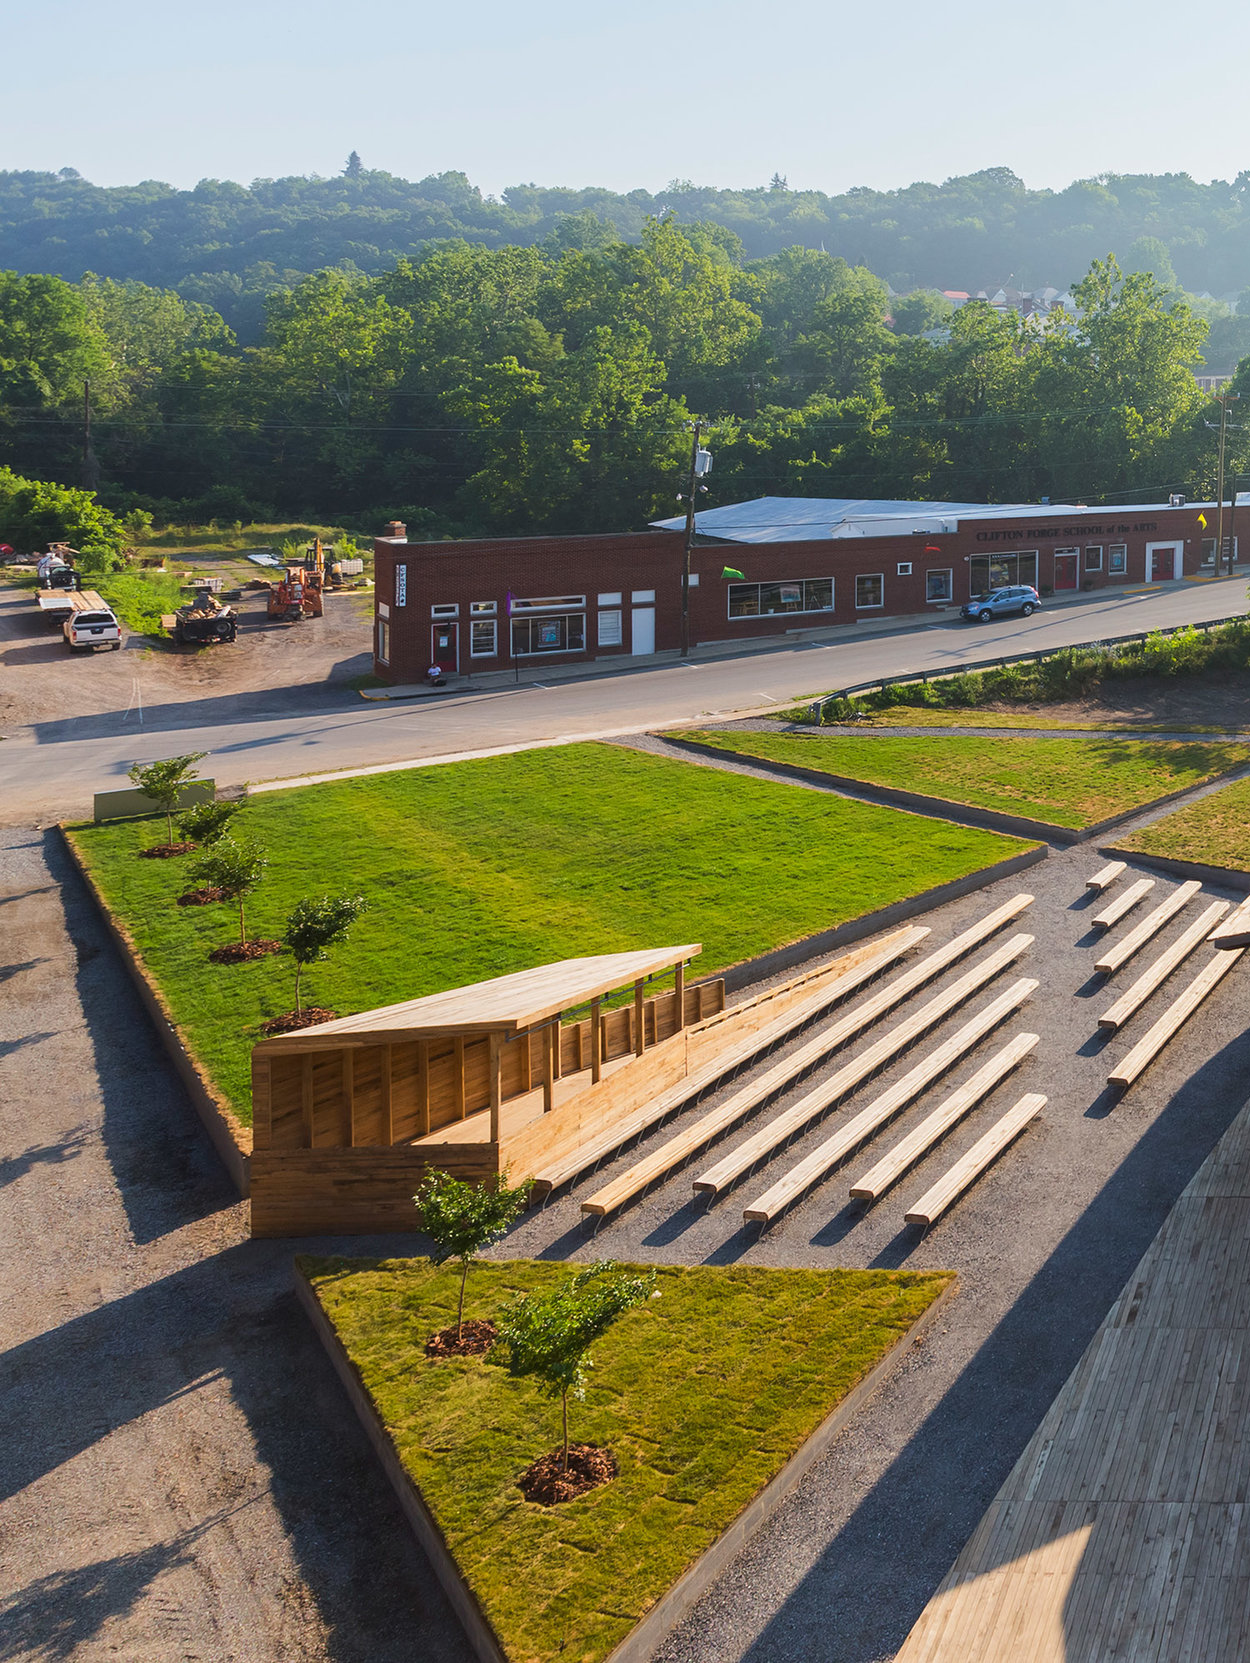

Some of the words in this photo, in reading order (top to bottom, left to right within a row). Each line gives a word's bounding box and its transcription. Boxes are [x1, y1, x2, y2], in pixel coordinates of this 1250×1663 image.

[976, 530, 1024, 542] CLIFTON
[1027, 528, 1060, 539] FORGE
[1063, 525, 1105, 537] SCHOOL
[1118, 524, 1130, 533] the
[1133, 522, 1157, 532] ARTS
